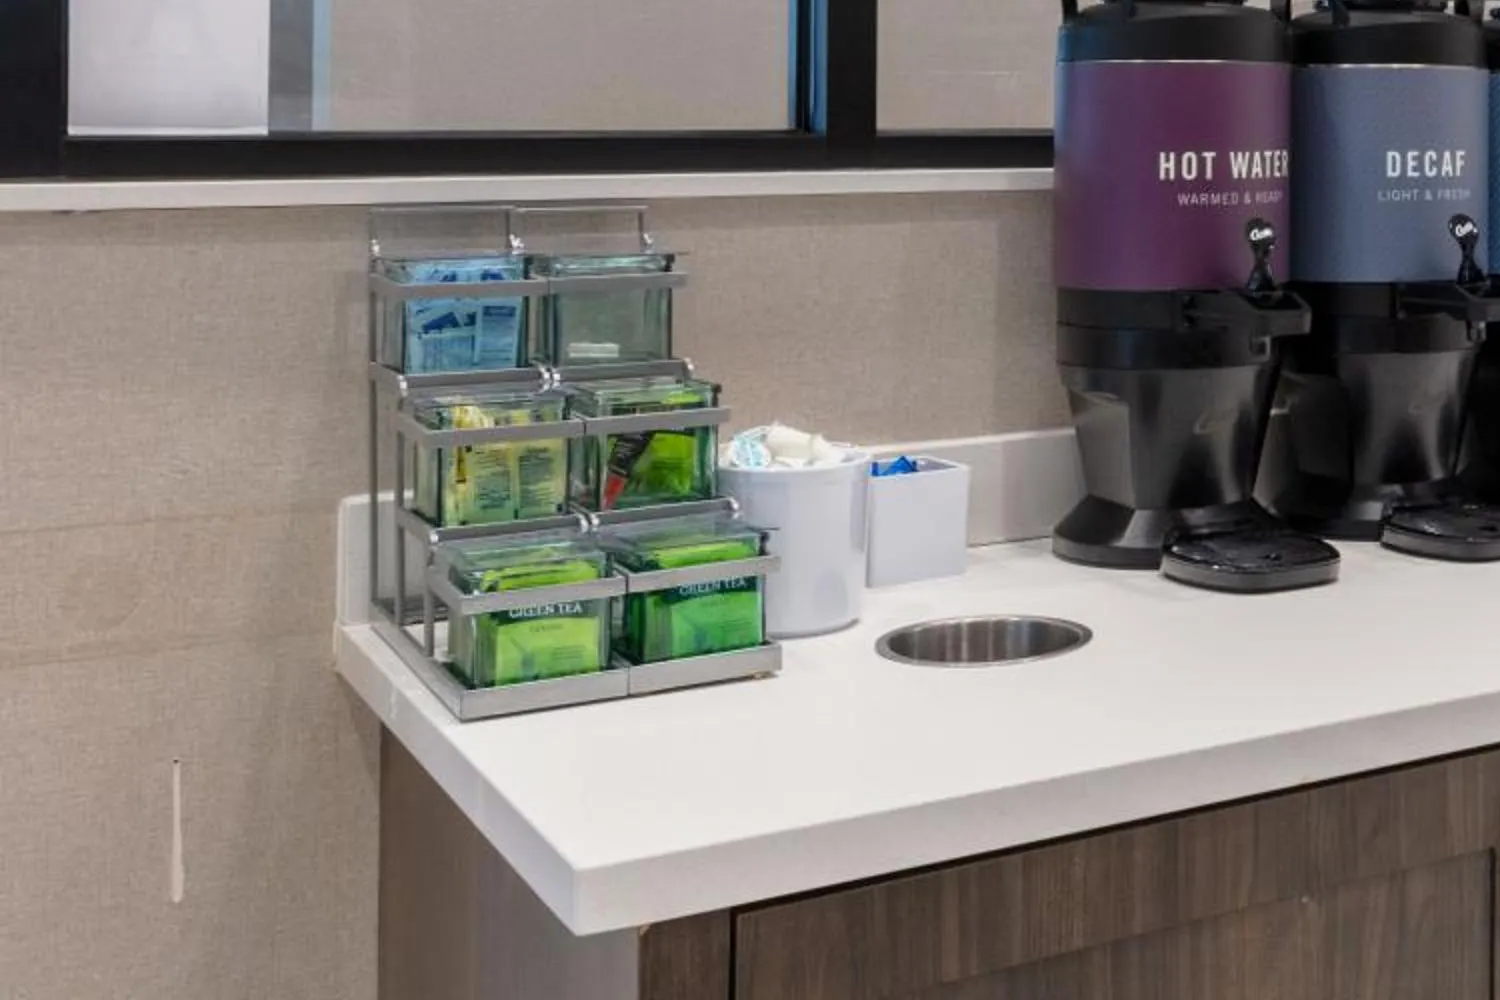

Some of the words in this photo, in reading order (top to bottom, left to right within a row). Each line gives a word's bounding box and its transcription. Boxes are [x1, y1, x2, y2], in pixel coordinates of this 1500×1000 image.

[1159, 151, 1217, 181] HOT
[1229, 150, 1289, 180] WATER
[1386, 150, 1467, 177] DECAF
[1177, 191, 1239, 207] WARMED
[1377, 188, 1419, 202] LIGHT
